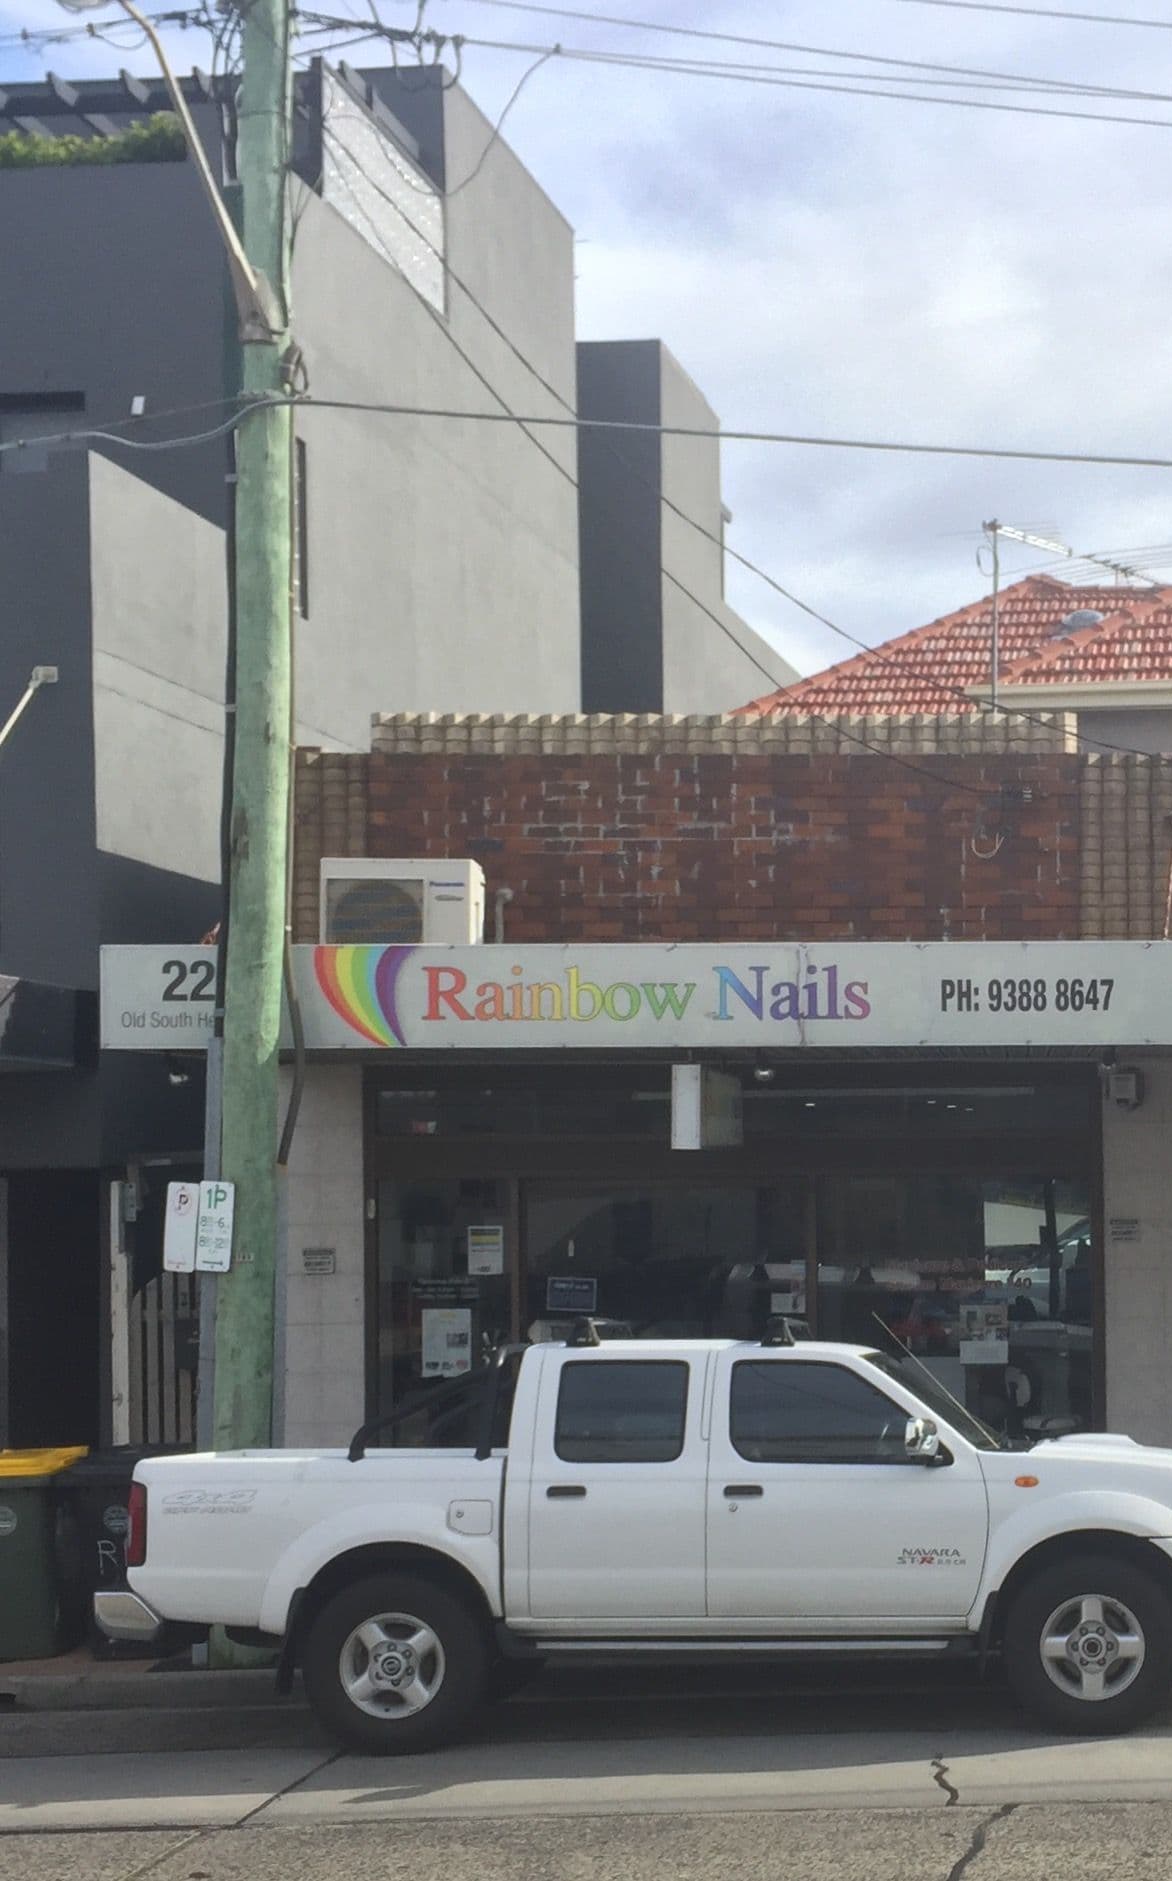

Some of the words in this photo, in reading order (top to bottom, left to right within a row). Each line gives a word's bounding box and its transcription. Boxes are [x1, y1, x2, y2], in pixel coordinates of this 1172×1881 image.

[421, 965, 696, 1021] Rainbow
[711, 965, 870, 1020] Nails
[941, 979, 980, 1012] PH:
[988, 978, 1047, 1012] 9388
[1055, 978, 1115, 1012] 8647
[121, 1011, 146, 1028] Old
[150, 1011, 193, 1028] South
[902, 1548, 961, 1557] NAVARA
